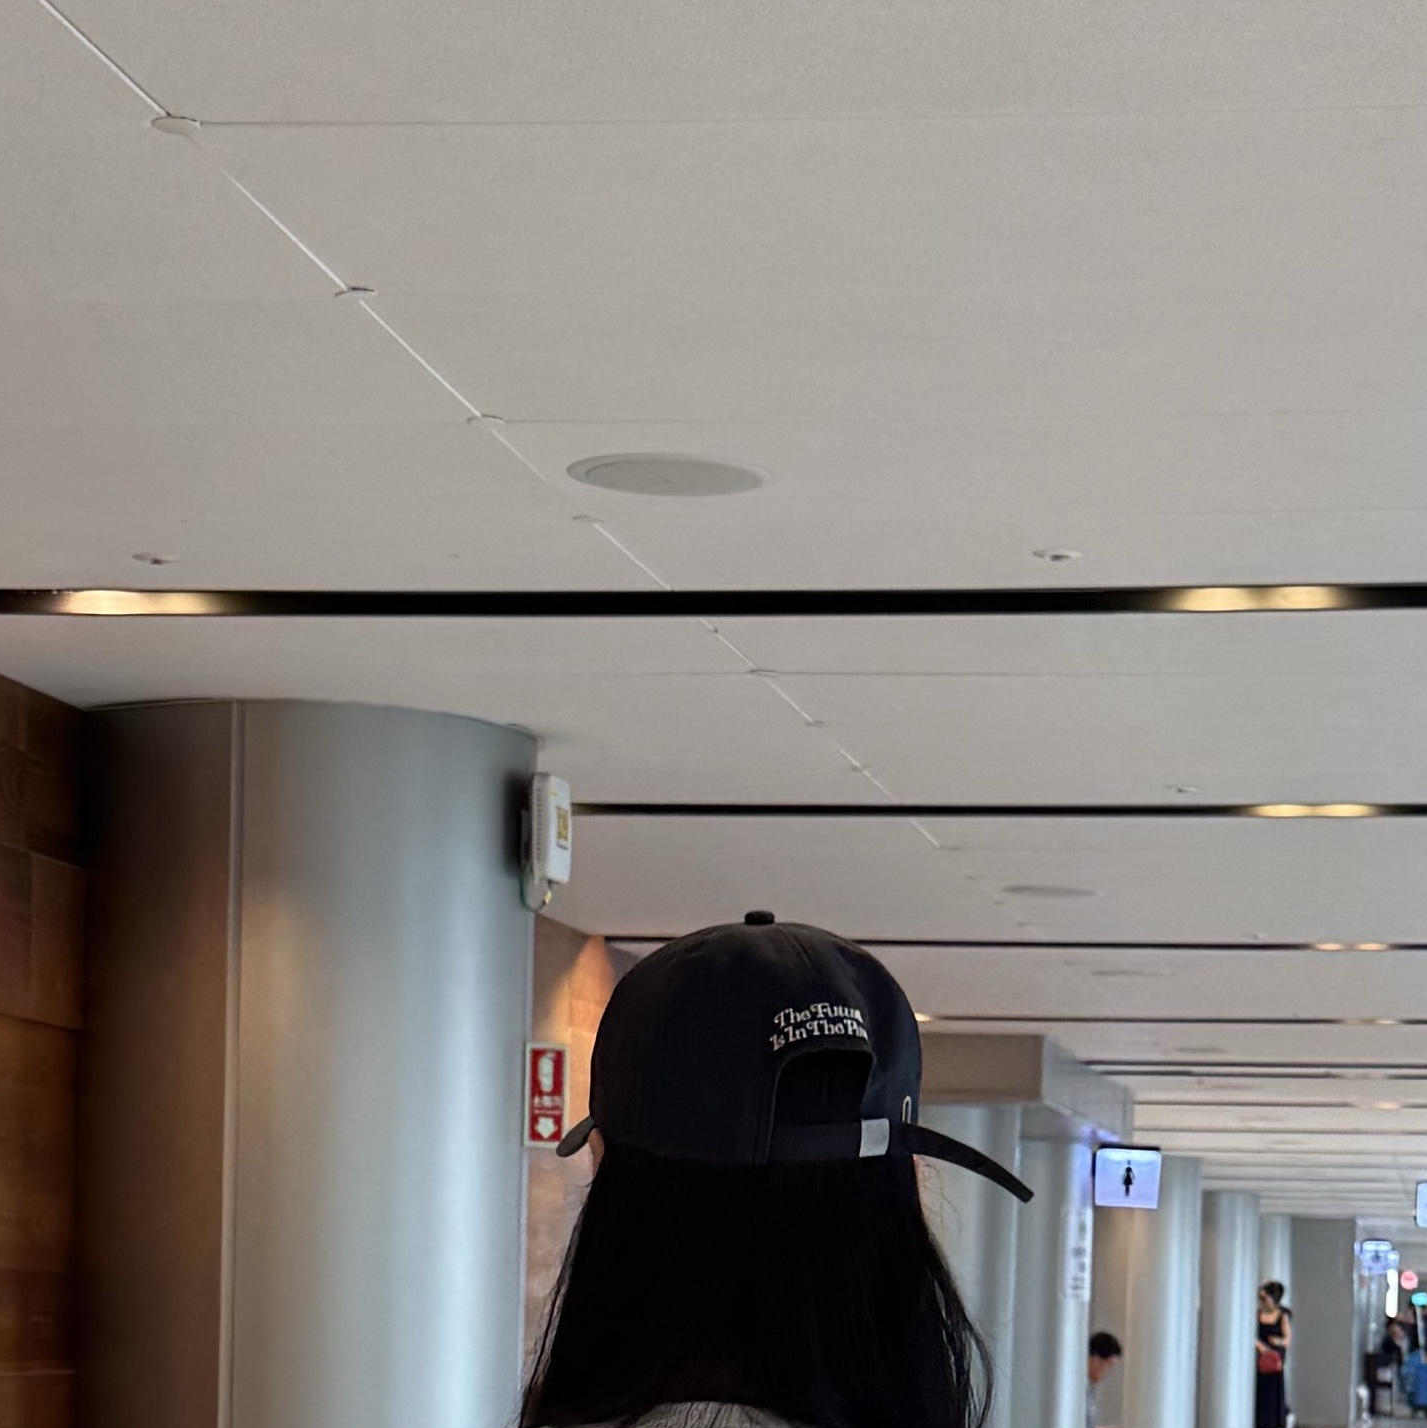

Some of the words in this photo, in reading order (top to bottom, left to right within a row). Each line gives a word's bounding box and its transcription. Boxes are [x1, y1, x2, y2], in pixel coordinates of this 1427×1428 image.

[774, 1008, 811, 1029] The
[769, 1034, 786, 1051] Is
[784, 1026, 808, 1042] In
[806, 1019, 845, 1036] The
